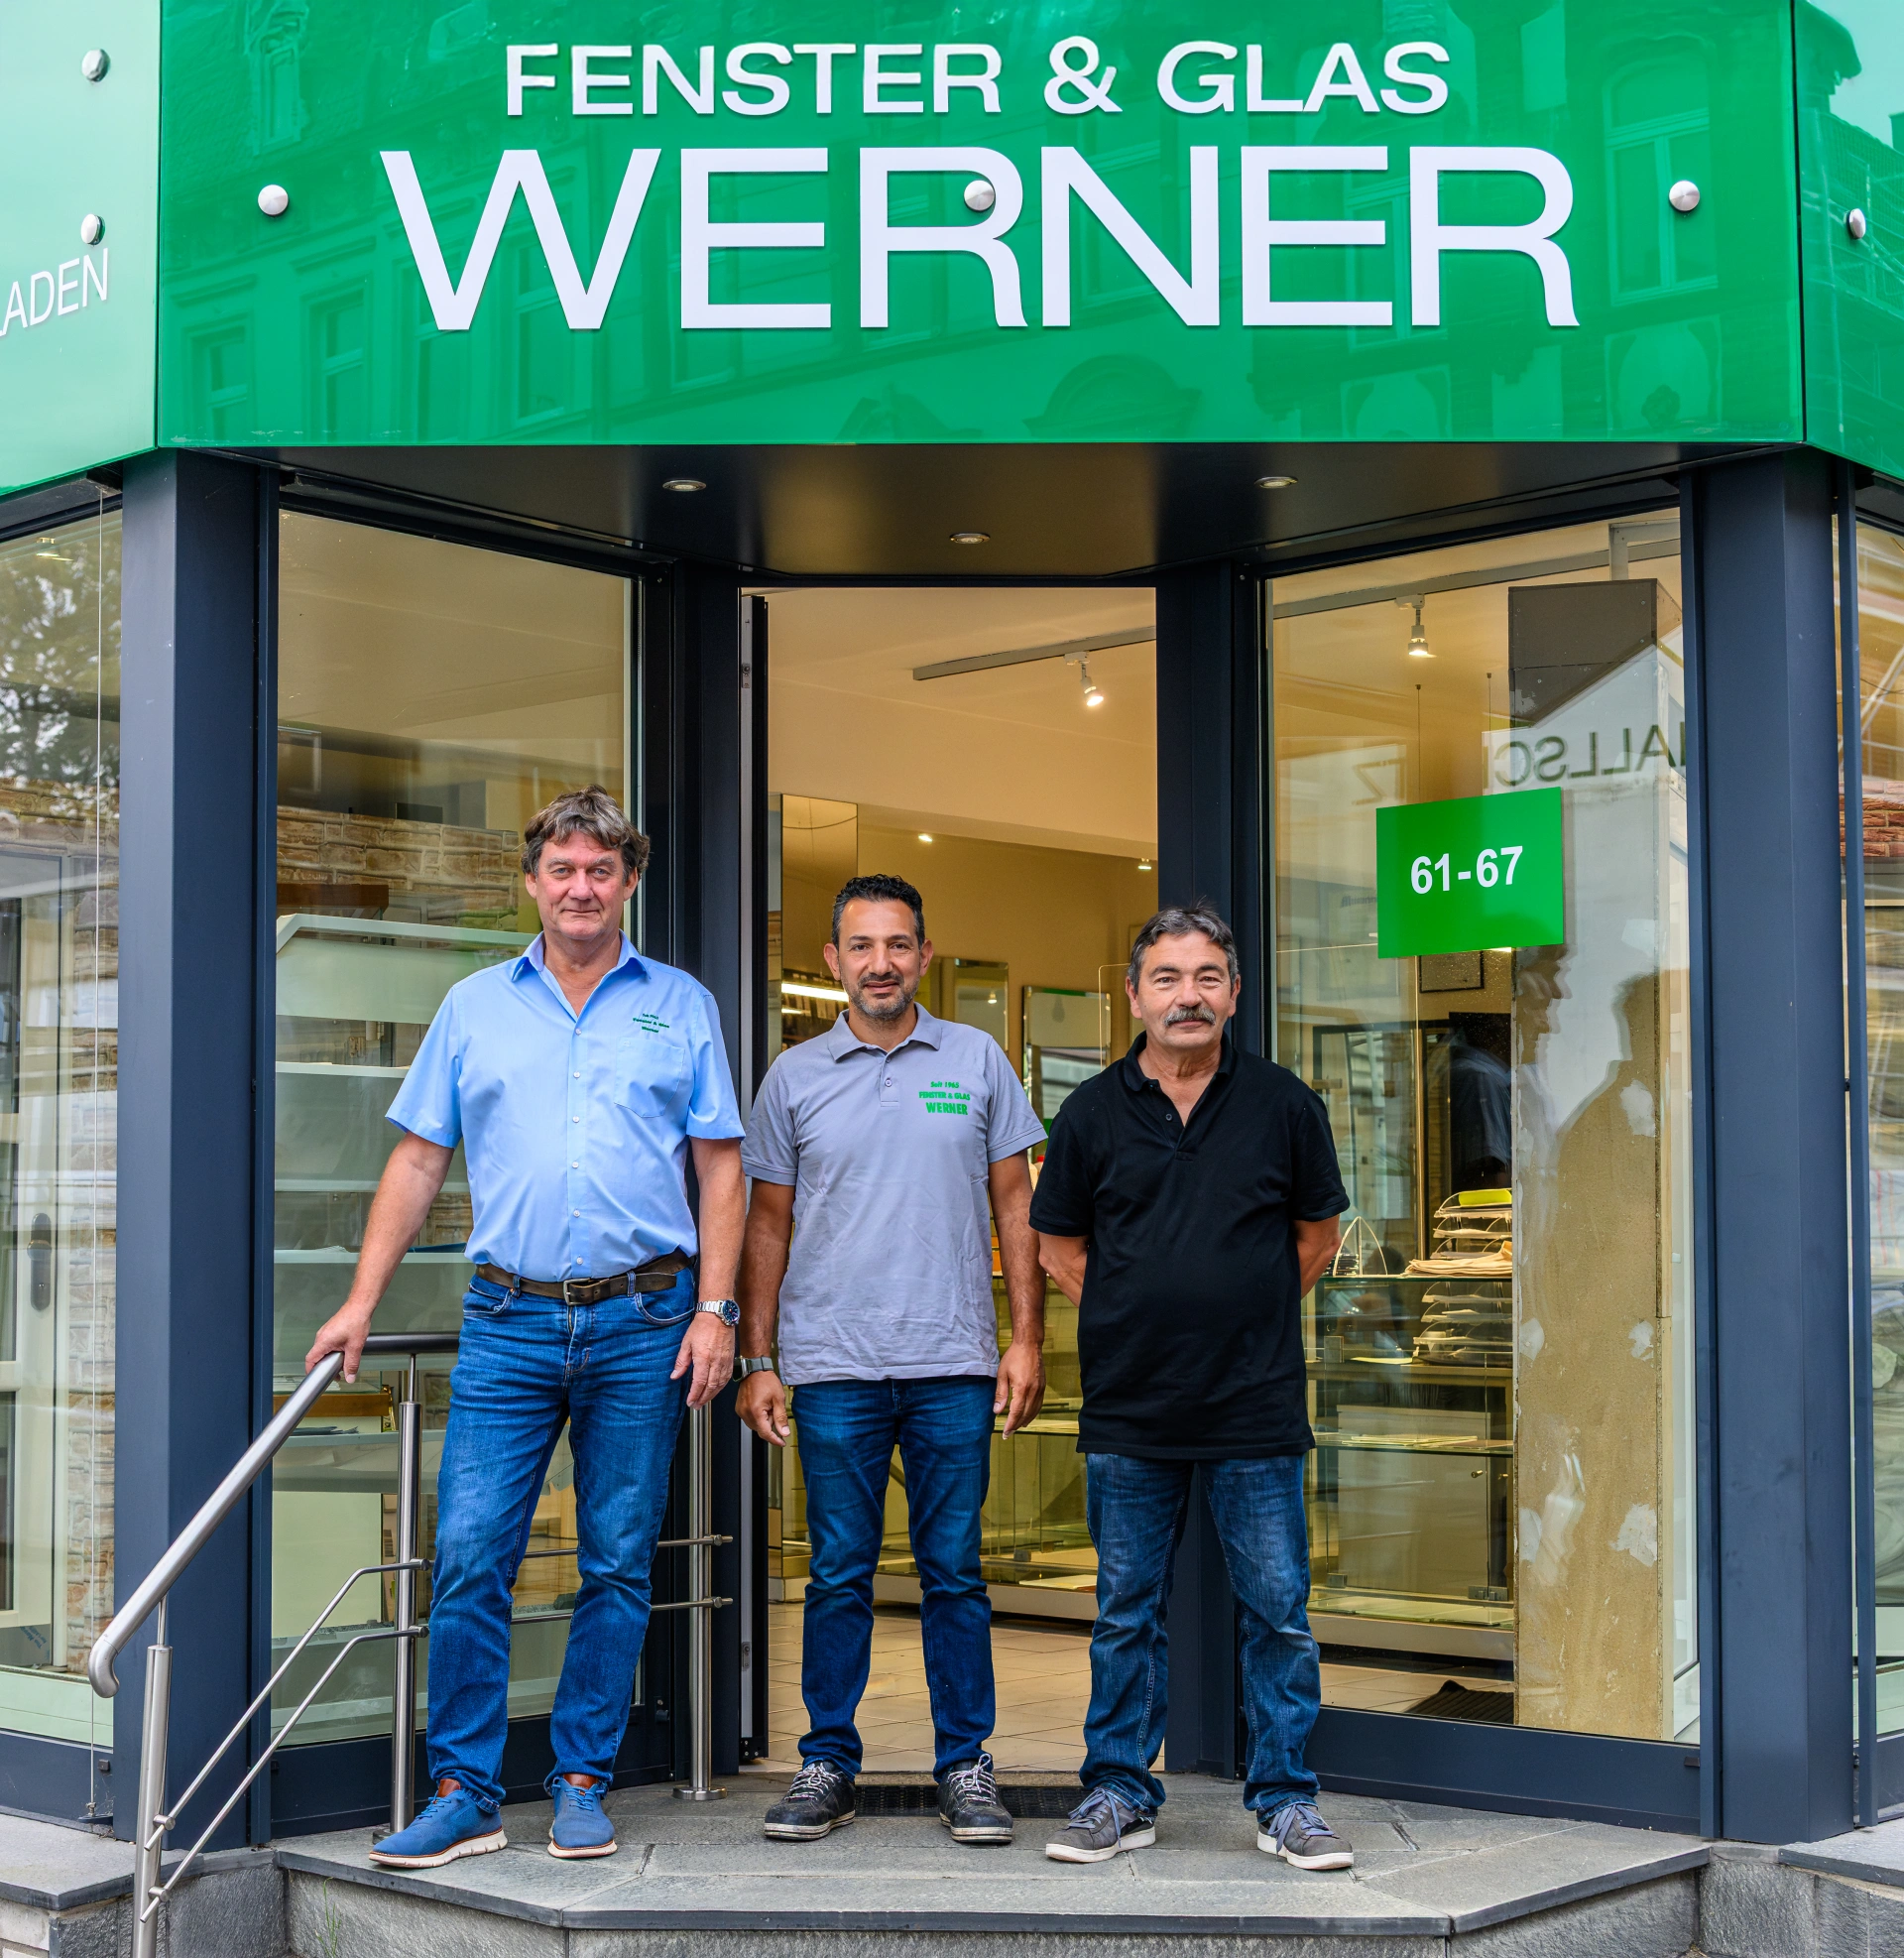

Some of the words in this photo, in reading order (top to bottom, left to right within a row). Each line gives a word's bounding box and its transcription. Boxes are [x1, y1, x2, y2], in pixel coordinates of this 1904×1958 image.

[507, 44, 1002, 116] FENSTER
[1044, 36, 1122, 114] &
[1157, 42, 1450, 114] GLAS
[380, 146, 1580, 330] WERNER
[0, 247, 109, 337] ADEN
[1410, 845, 1523, 895] 61-67
[925, 1102, 968, 1115] WERNER
